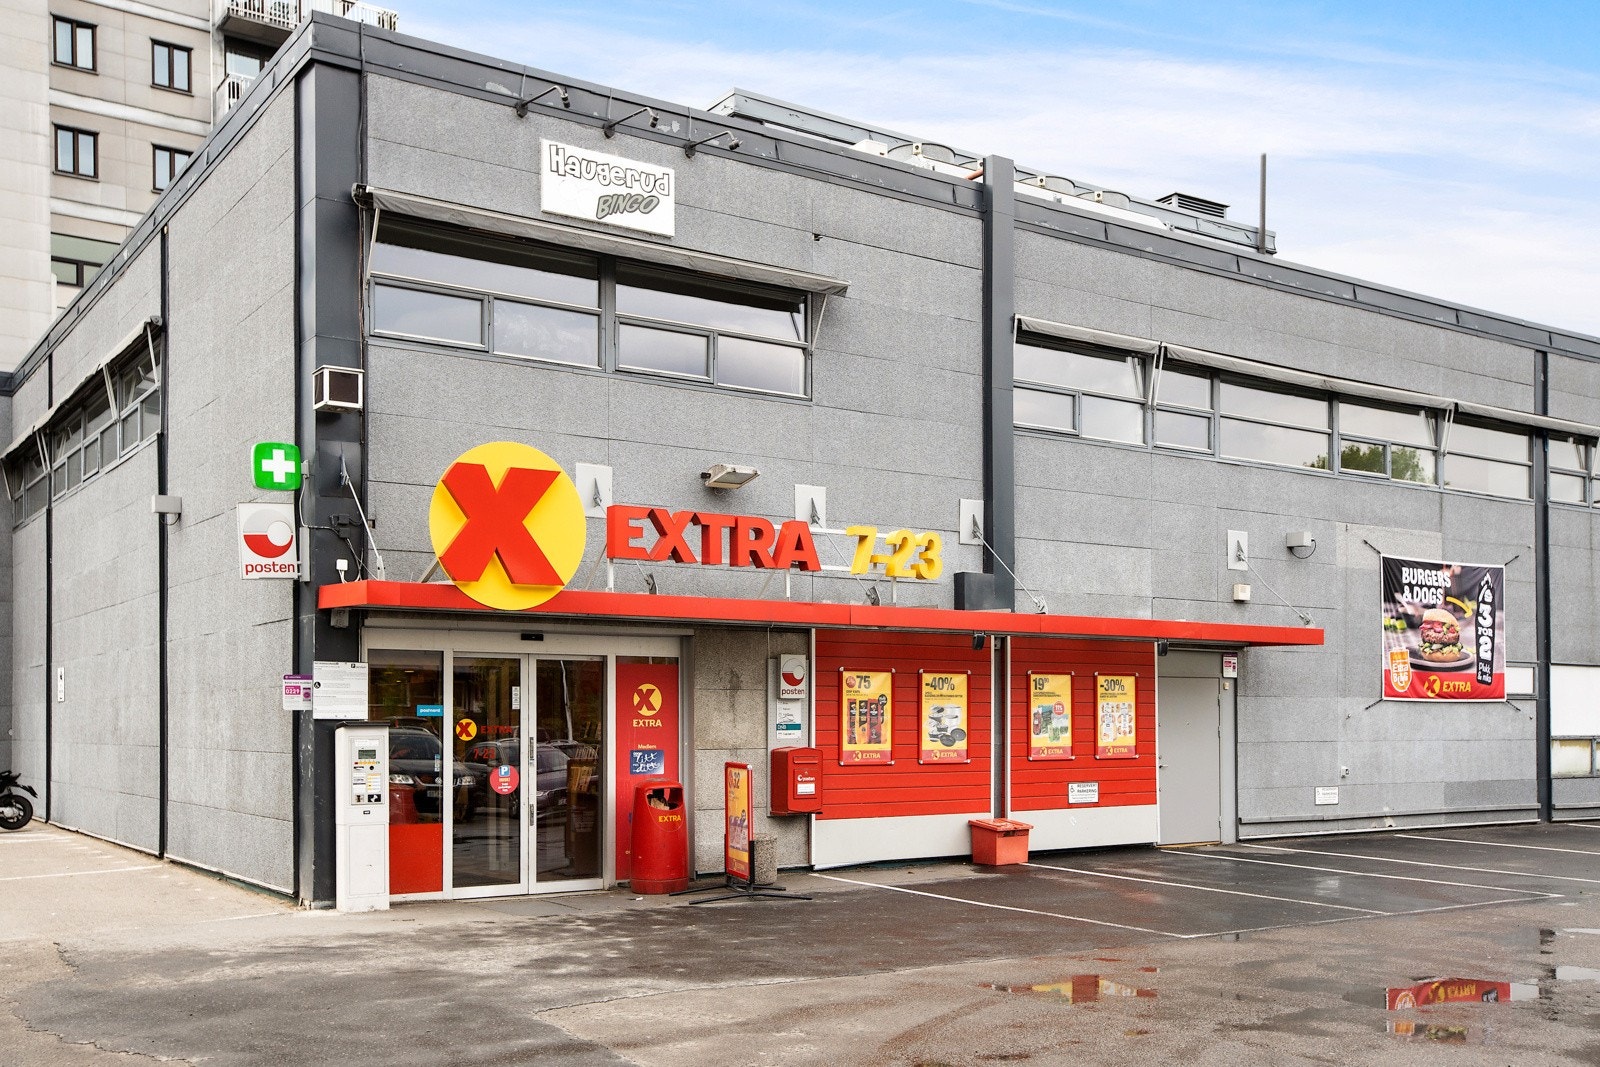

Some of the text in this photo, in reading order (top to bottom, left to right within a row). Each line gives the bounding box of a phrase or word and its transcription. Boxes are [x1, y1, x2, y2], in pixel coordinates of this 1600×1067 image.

[549, 144, 670, 196] Haugerud
[596, 193, 660, 220] BINGO
[439, 462, 565, 586] X
[606, 504, 822, 572] EXTRA
[846, 525, 944, 580] 7-23
[245, 561, 295, 576] posten
[1402, 567, 1451, 588] BURGERS
[1402, 586, 1443, 605] & DOGS
[1478, 603, 1493, 628] 3
[1478, 627, 1493, 637] FOR
[1479, 636, 1493, 661] 2
[856, 675, 871, 689] 75
[925, 677, 955, 691] -40%
[1100, 679, 1125, 691] -30%
[1442, 681, 1472, 692] EXTRA
[781, 688, 805, 696] posten
[480, 726, 513, 734] EXTRA
[632, 719, 662, 727] EXTRA
[473, 747, 496, 759] 7-23
[501, 766, 508, 776] P
[658, 814, 682, 823] EXTRA
